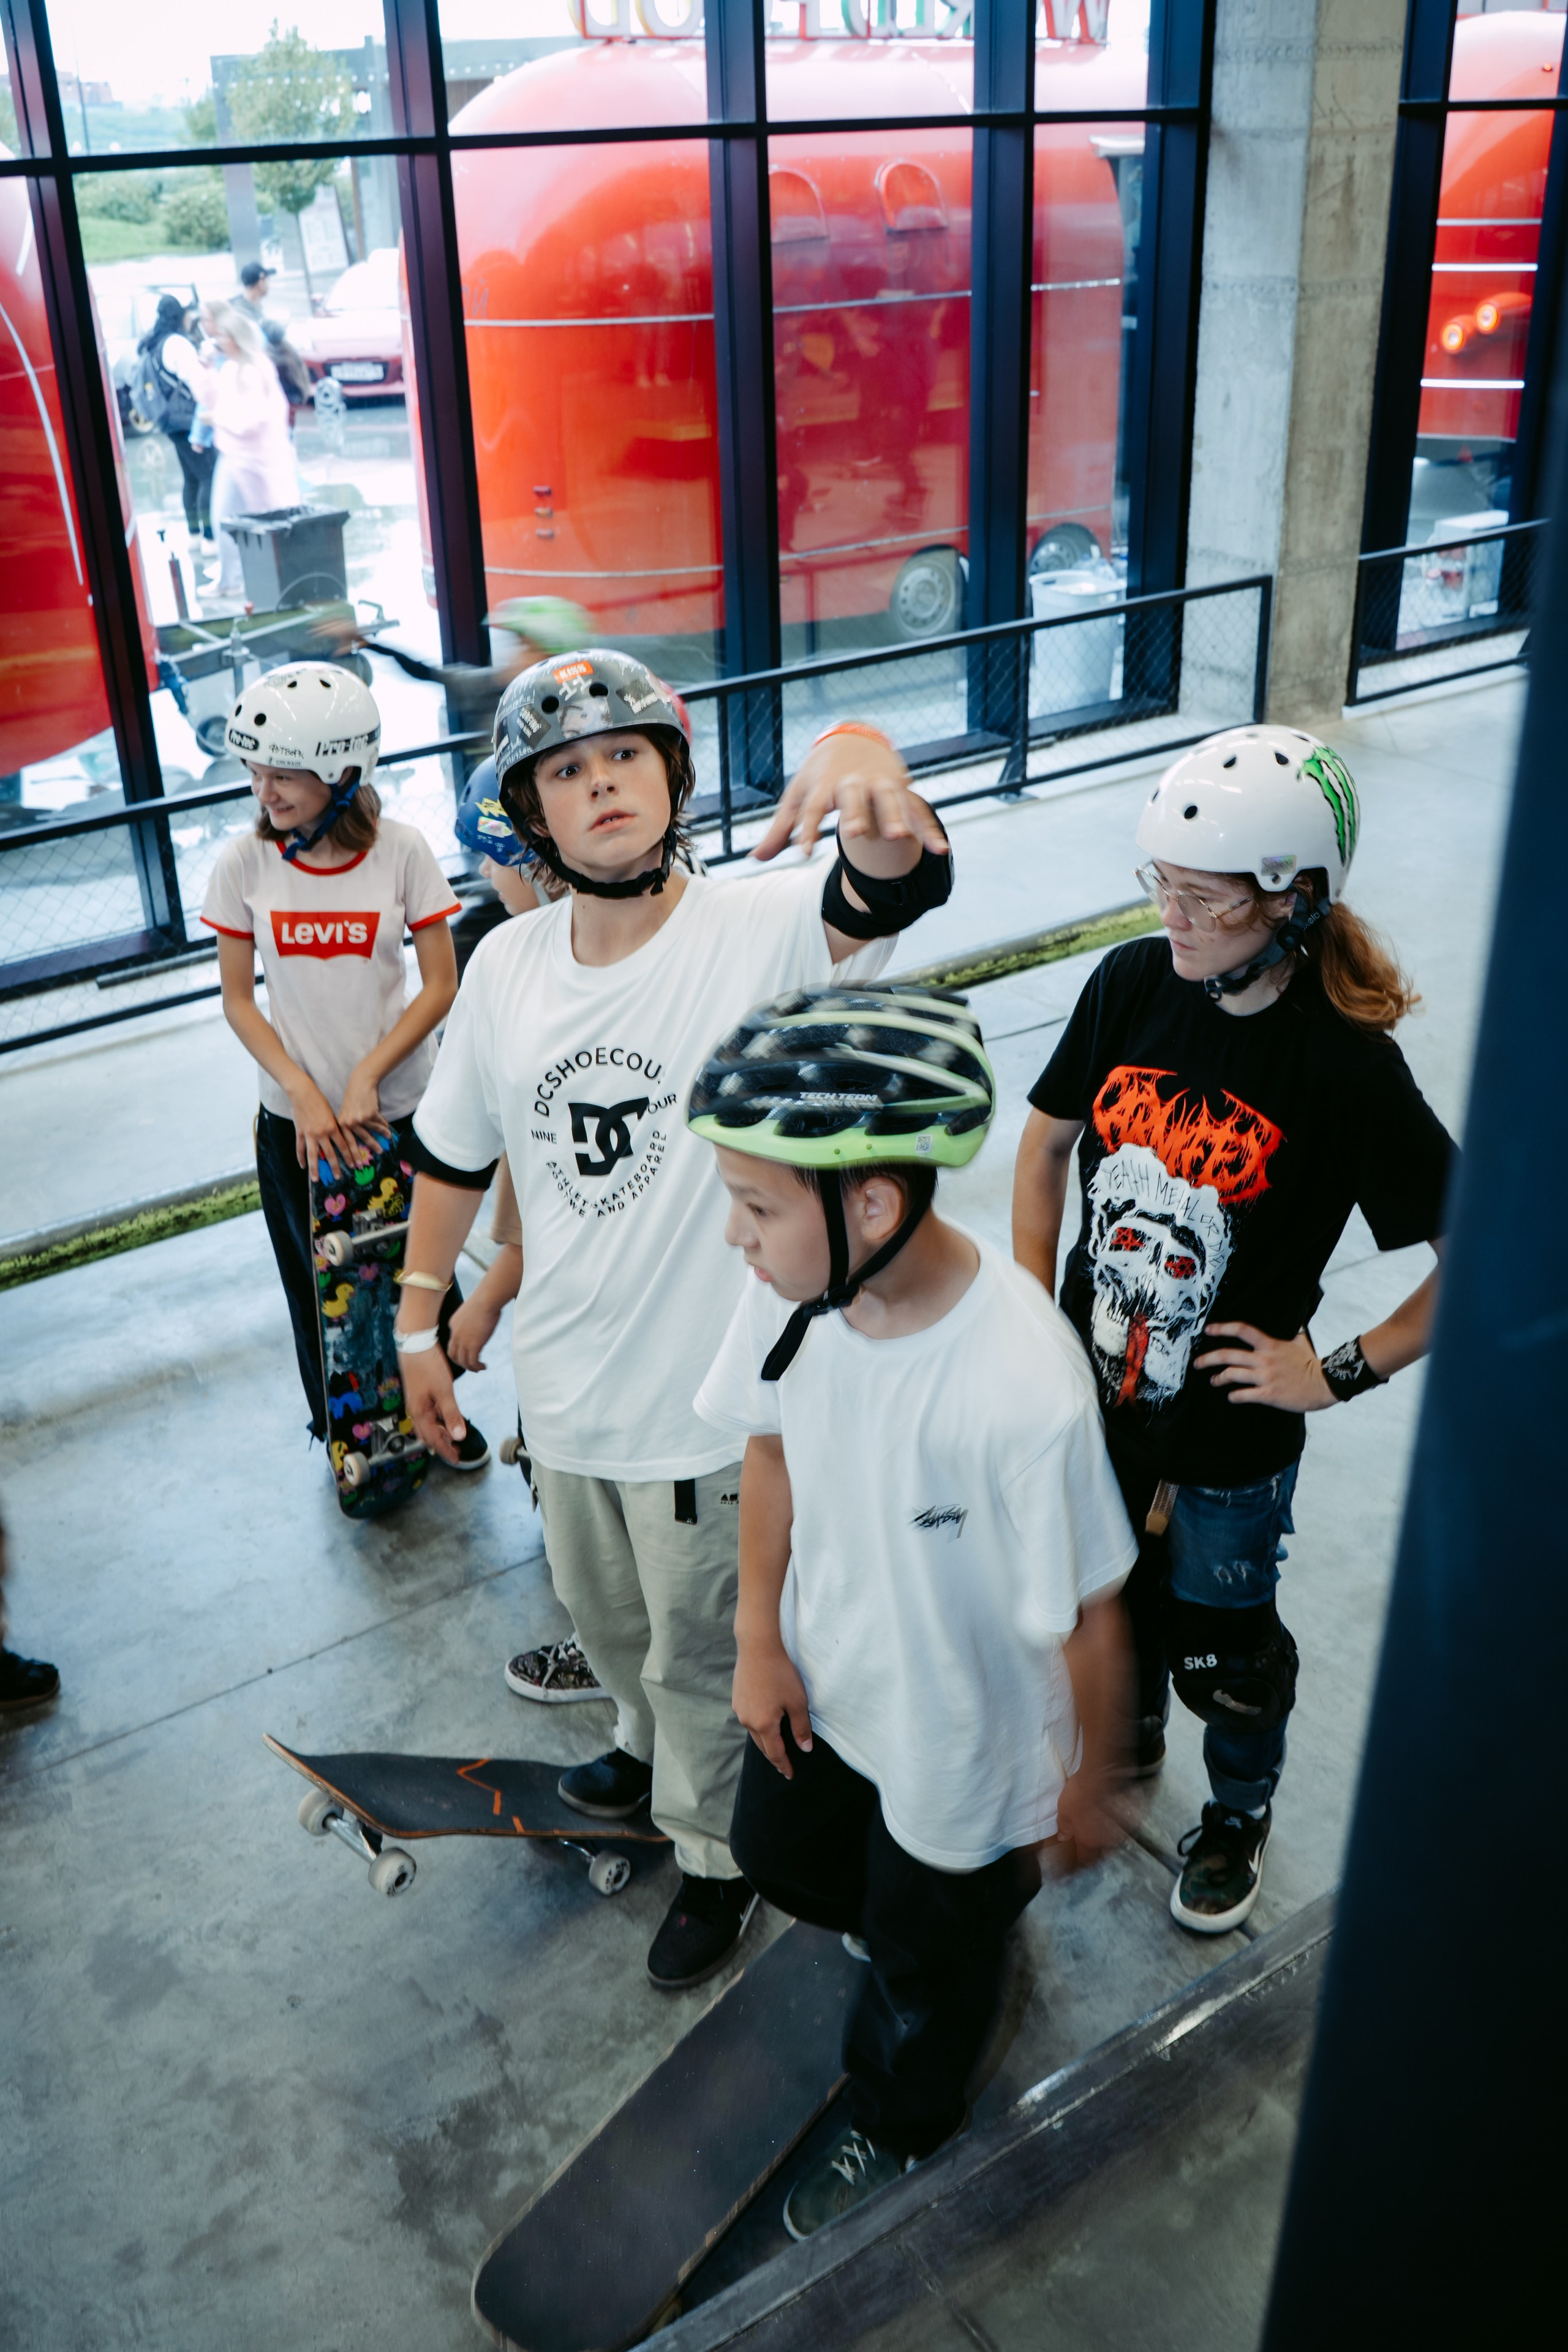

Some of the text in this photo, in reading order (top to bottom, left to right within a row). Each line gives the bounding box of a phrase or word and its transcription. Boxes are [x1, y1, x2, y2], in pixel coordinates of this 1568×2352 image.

[534, 1047, 663, 1117] DCSHOECOU
[531, 1094, 677, 1144] NINE OUR
[597, 1201, 625, 1218] AND
[631, 1133, 666, 1201] APPAREL
[1184, 1653, 1218, 1670] SK8
